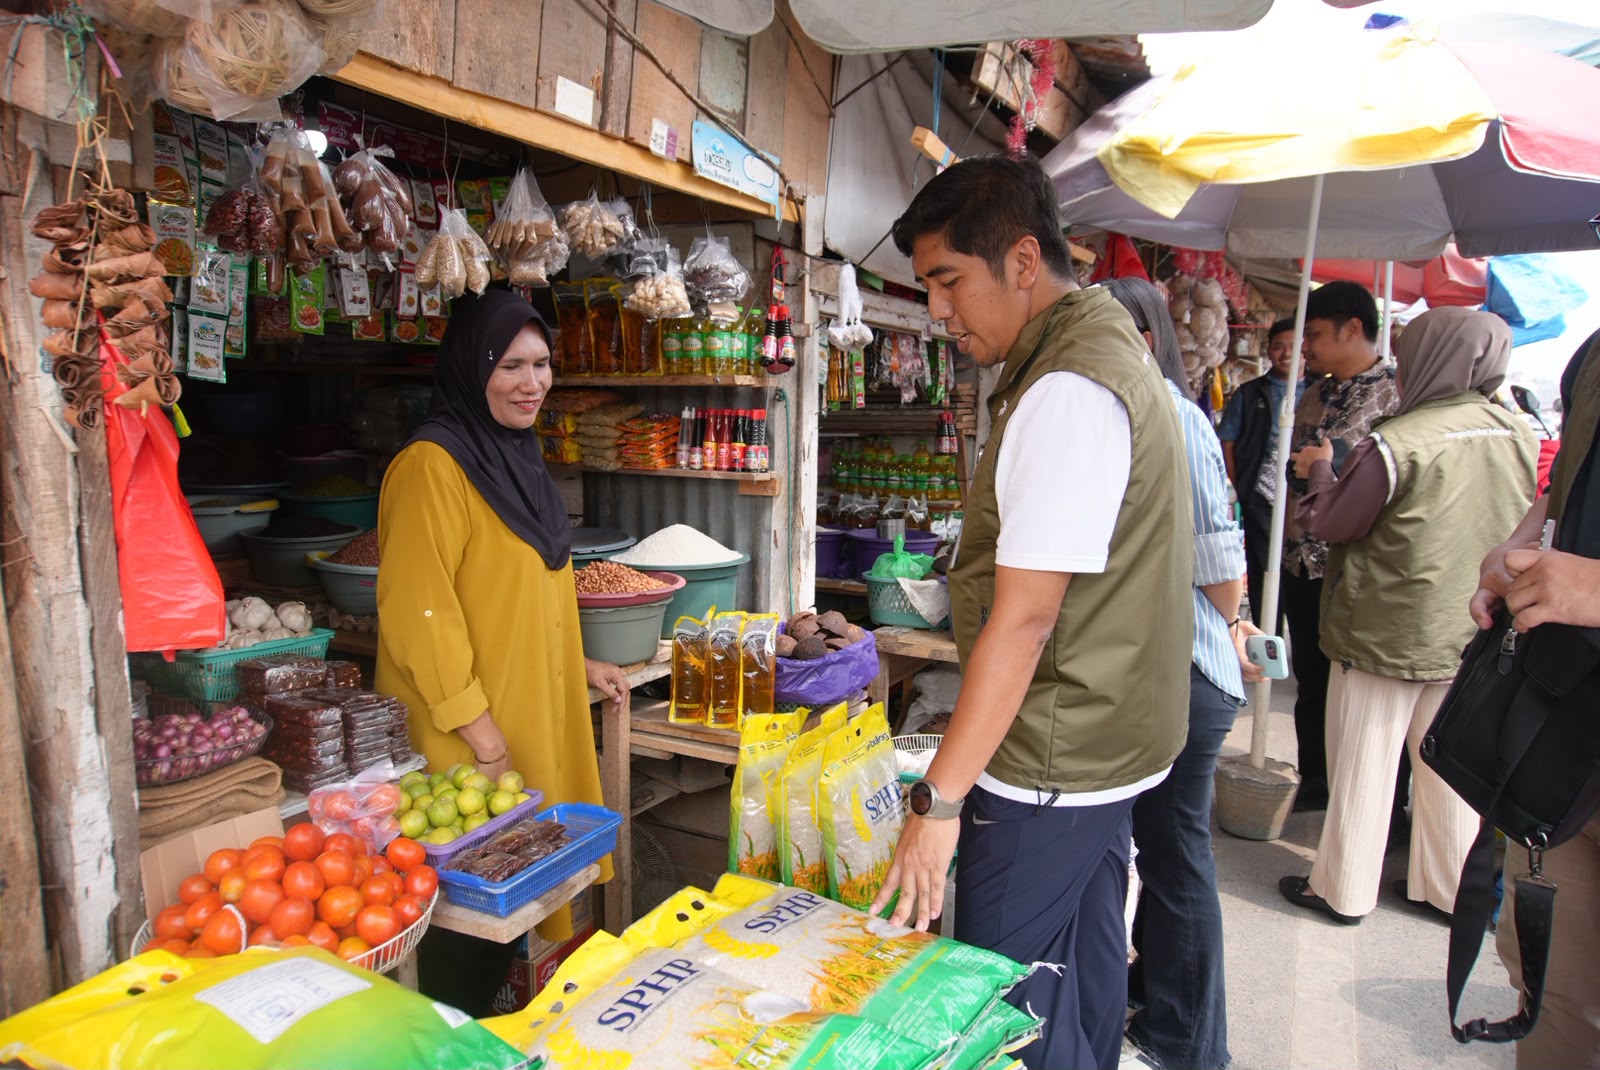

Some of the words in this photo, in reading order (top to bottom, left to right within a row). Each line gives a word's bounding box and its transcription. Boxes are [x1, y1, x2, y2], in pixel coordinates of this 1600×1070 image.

[744, 891, 823, 933] SPHP
[597, 958, 701, 1033] SPHP
[747, 1050, 771, 1069] 5
[769, 1036, 789, 1058] kg
